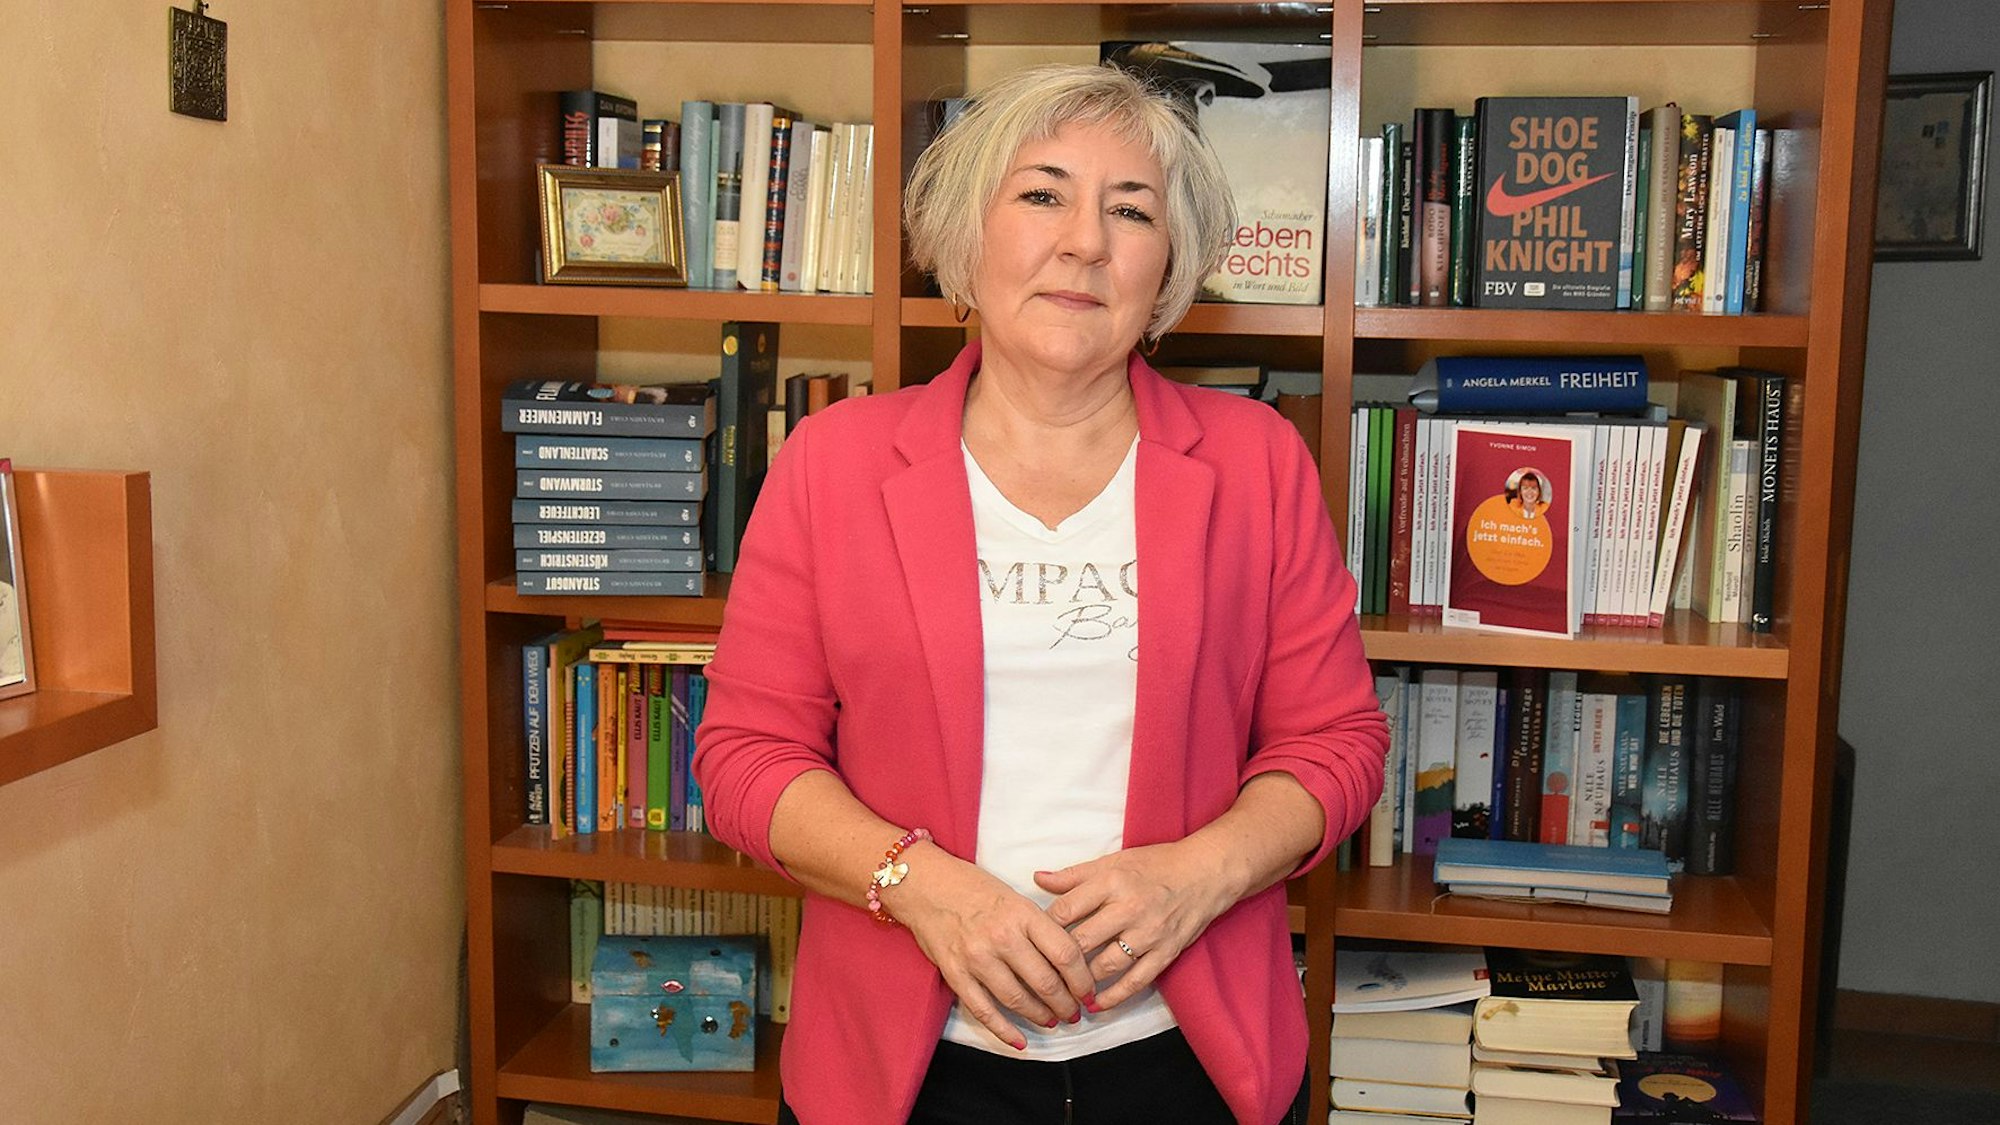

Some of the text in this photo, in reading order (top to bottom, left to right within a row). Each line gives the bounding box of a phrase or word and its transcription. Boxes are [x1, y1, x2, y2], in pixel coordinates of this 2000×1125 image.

[1508, 117, 1598, 149] SHOE
[1701, 133, 1710, 171] HERBSTES
[1516, 152, 1589, 185] DOG
[1681, 153, 1698, 239] Mary Lawson
[1698, 189, 1706, 213] LICHT
[1513, 206, 1588, 237] PHIL
[1696, 215, 1704, 250] LETZTEN
[1226, 221, 1312, 249] eben
[1486, 240, 1613, 273] KNIGHT
[1696, 250, 1702, 262] IM
[1244, 280, 1266, 291] Wort
[1267, 282, 1286, 292] und
[1484, 282, 1516, 296] FBV
[1463, 372, 1638, 388] ANGELA MERKEL FREIHEIT
[519, 409, 602, 426] FLAMMENMEER
[538, 446, 608, 461] SCHATTENLAND
[1400, 424, 1410, 476] Weihnachten
[1489, 442, 1537, 452] YVONNE SIMON
[540, 477, 602, 491] STURMWAND
[1400, 477, 1408, 492] auf
[1761, 388, 1781, 563] Heide Michels MONETS HAUS
[1595, 486, 1603, 502] jetzt
[1608, 487, 1616, 502] jetzt
[1636, 488, 1644, 503] jetzt
[1676, 487, 1685, 502] jetzt
[539, 506, 600, 519] LEUCHTFEUER
[1398, 494, 1407, 534] Vorfreude
[1594, 503, 1602, 528] mach's
[1607, 503, 1615, 528] mach's
[1620, 503, 1628, 528] mach's
[1648, 505, 1656, 530] mach's
[1670, 502, 1682, 528] mach's
[1727, 494, 1745, 552] Shaolin
[538, 530, 606, 544] GEZEITENSPIEL
[1473, 530, 1544, 547] jetzt einfach.
[1481, 519, 1538, 534] Ich mach's
[1668, 529, 1676, 539] Ich
[540, 554, 608, 569] KÜSTENSTRICH
[545, 577, 600, 591] STRANDGUT
[1724, 571, 1733, 601] Bernhard
[527, 651, 538, 678] WEG
[528, 680, 539, 704] DEM
[528, 706, 539, 728] AUF
[633, 698, 642, 740] ELLIS KAUT
[652, 700, 661, 741] ELLIS KAUT
[1519, 687, 1532, 757] letzten Tage
[1659, 685, 1672, 744] DIE LEBENDEN
[1670, 684, 1684, 746] UND DIE TOTEN
[1713, 704, 1725, 727] Wald
[1592, 731, 1602, 753] UNTER
[1713, 729, 1723, 741] Im
[1511, 749, 1520, 767] Die
[1618, 730, 1629, 797] NELE NEUHAUS
[1628, 774, 1636, 789] WER
[1656, 767, 1667, 796] NELE
[1667, 751, 1680, 812] NEUHAUS
[1708, 753, 1724, 795] NEUHAUS
[1584, 772, 1594, 802] NELE
[1593, 759, 1605, 815] NEUHAUS
[1707, 800, 1722, 821] NELE
[1496, 969, 1619, 984] Meine Mutter
[1528, 979, 1607, 992] Marlene
